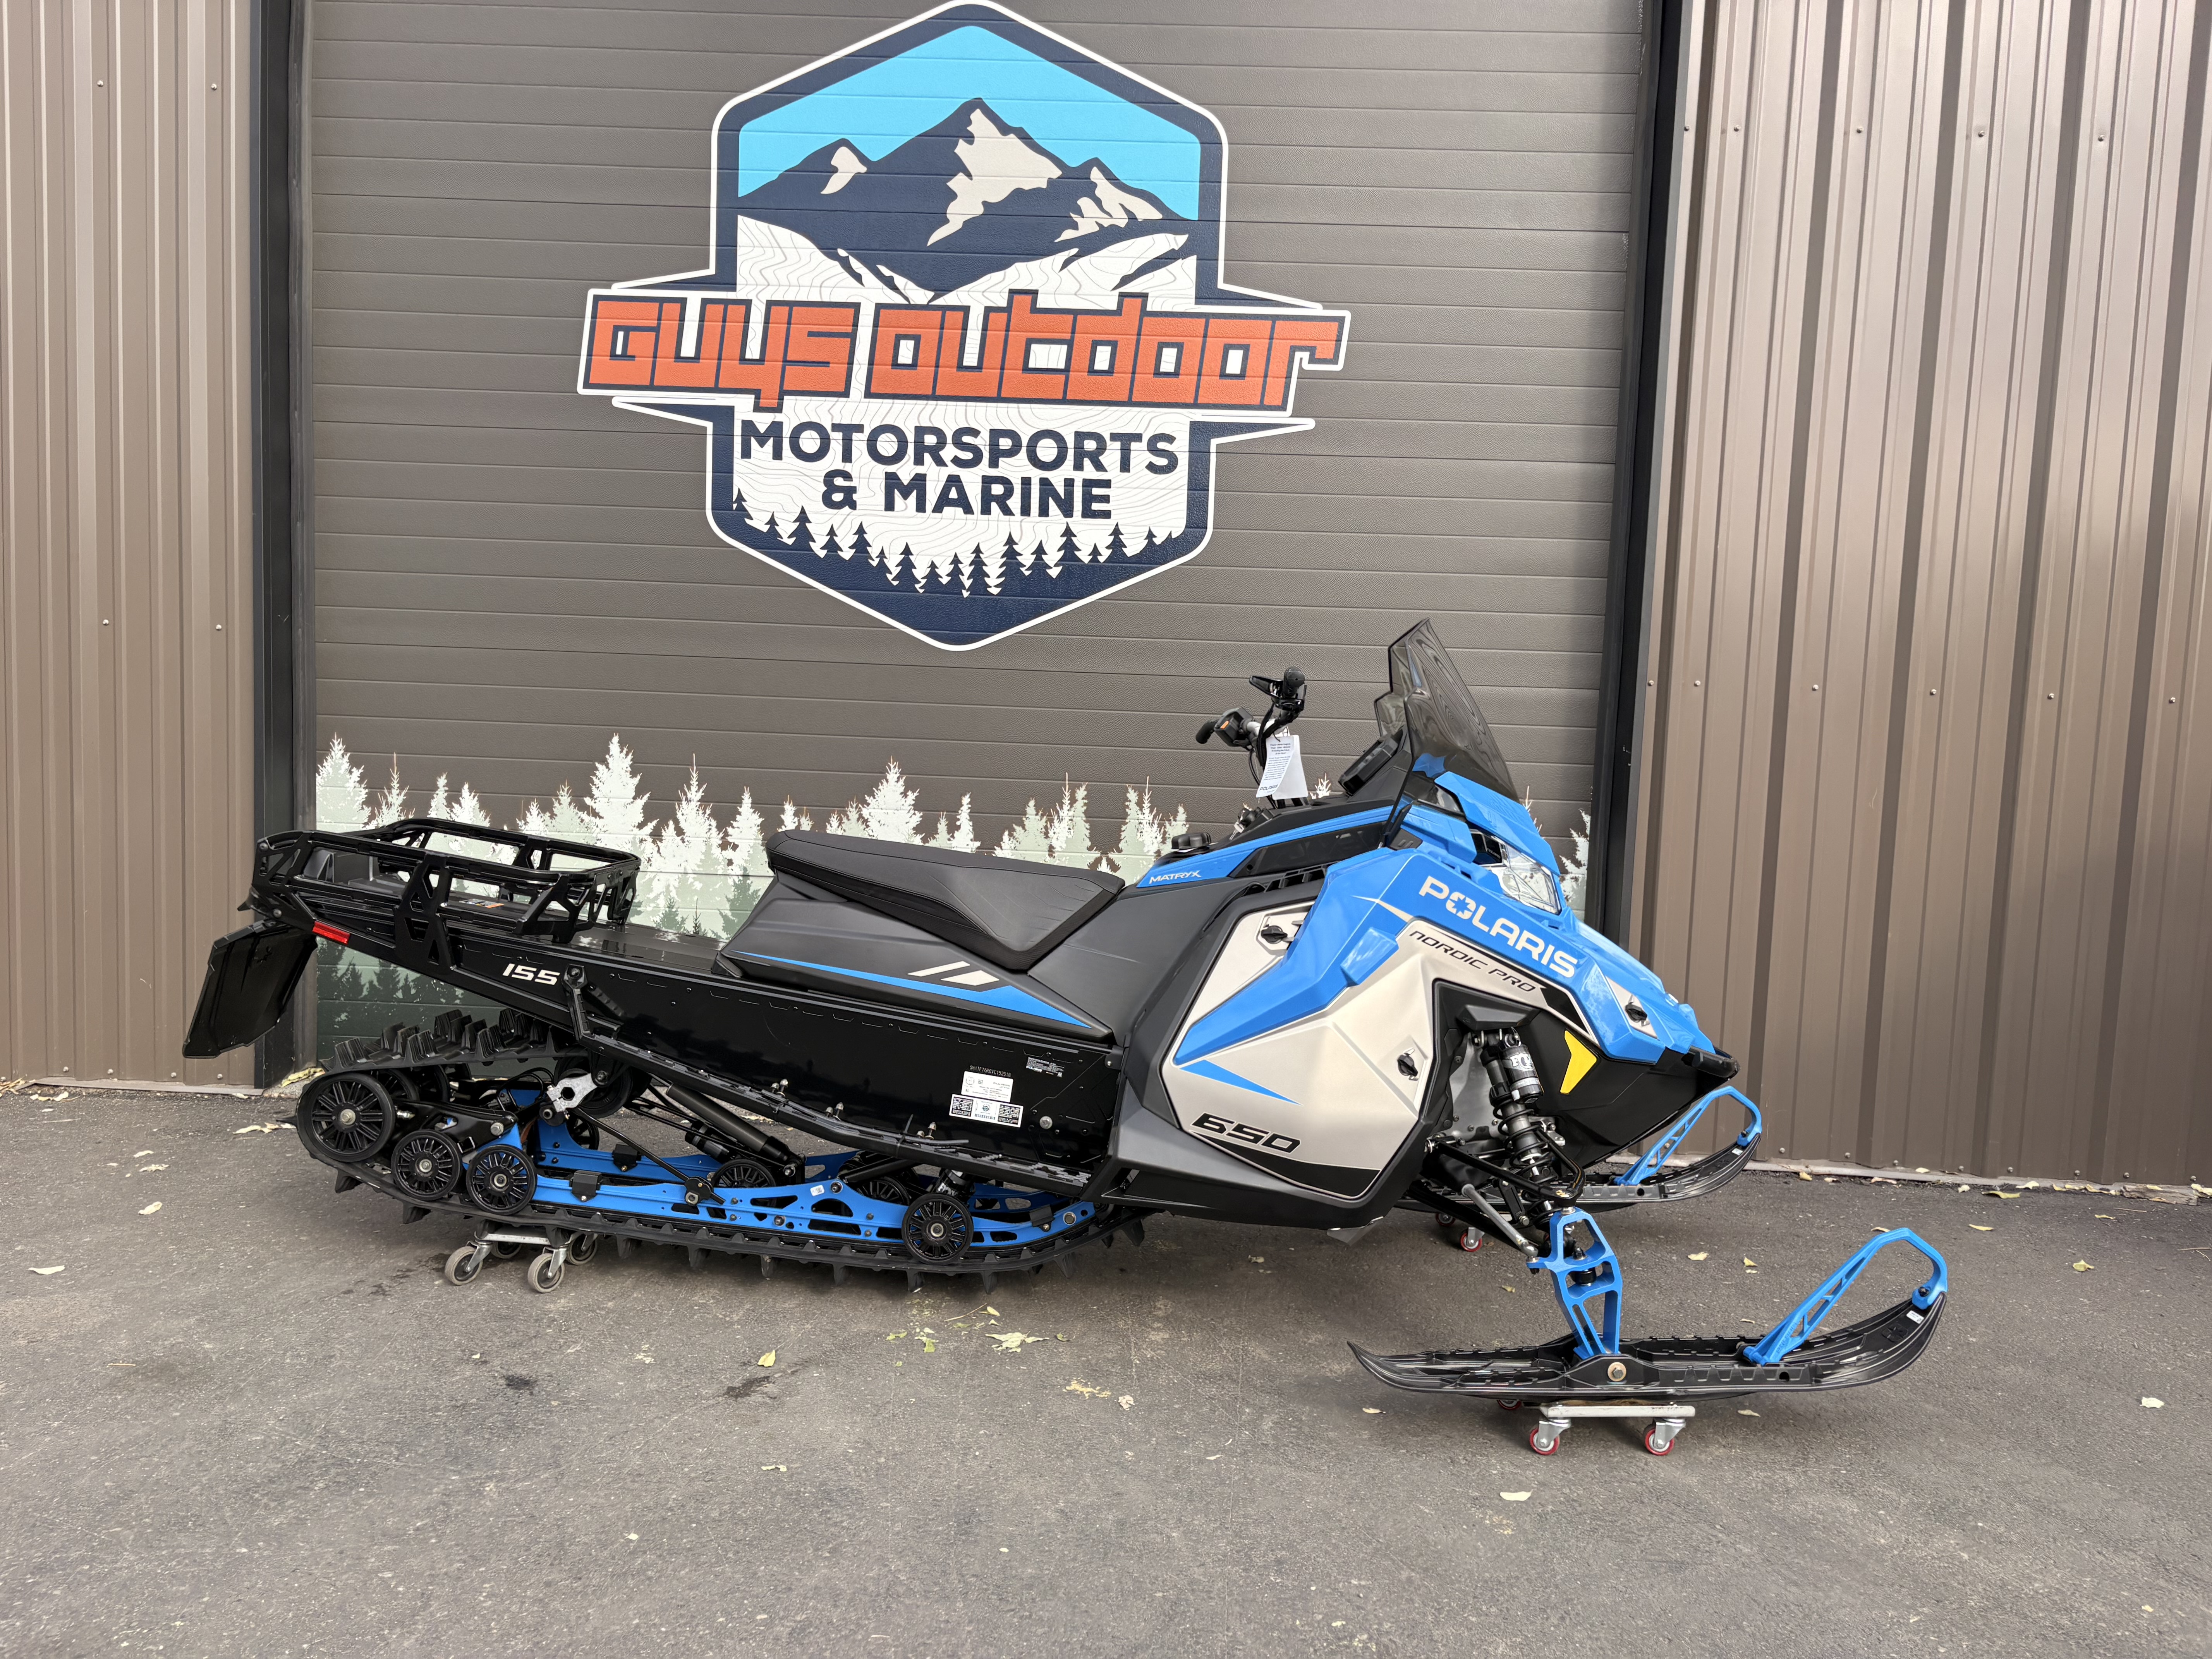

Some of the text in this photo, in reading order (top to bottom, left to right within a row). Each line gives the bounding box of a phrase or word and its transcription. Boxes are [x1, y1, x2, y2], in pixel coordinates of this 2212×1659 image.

[740, 419, 1179, 475] MOTORSPORTS
[821, 469, 1112, 519] & MARINE
[1149, 870, 1202, 884] MATRYX
[1419, 876, 1578, 978] POLARIS
[502, 963, 560, 985] 155
[1409, 931, 1536, 992] NORDIC PRO
[1190, 1111, 1301, 1154] 650
